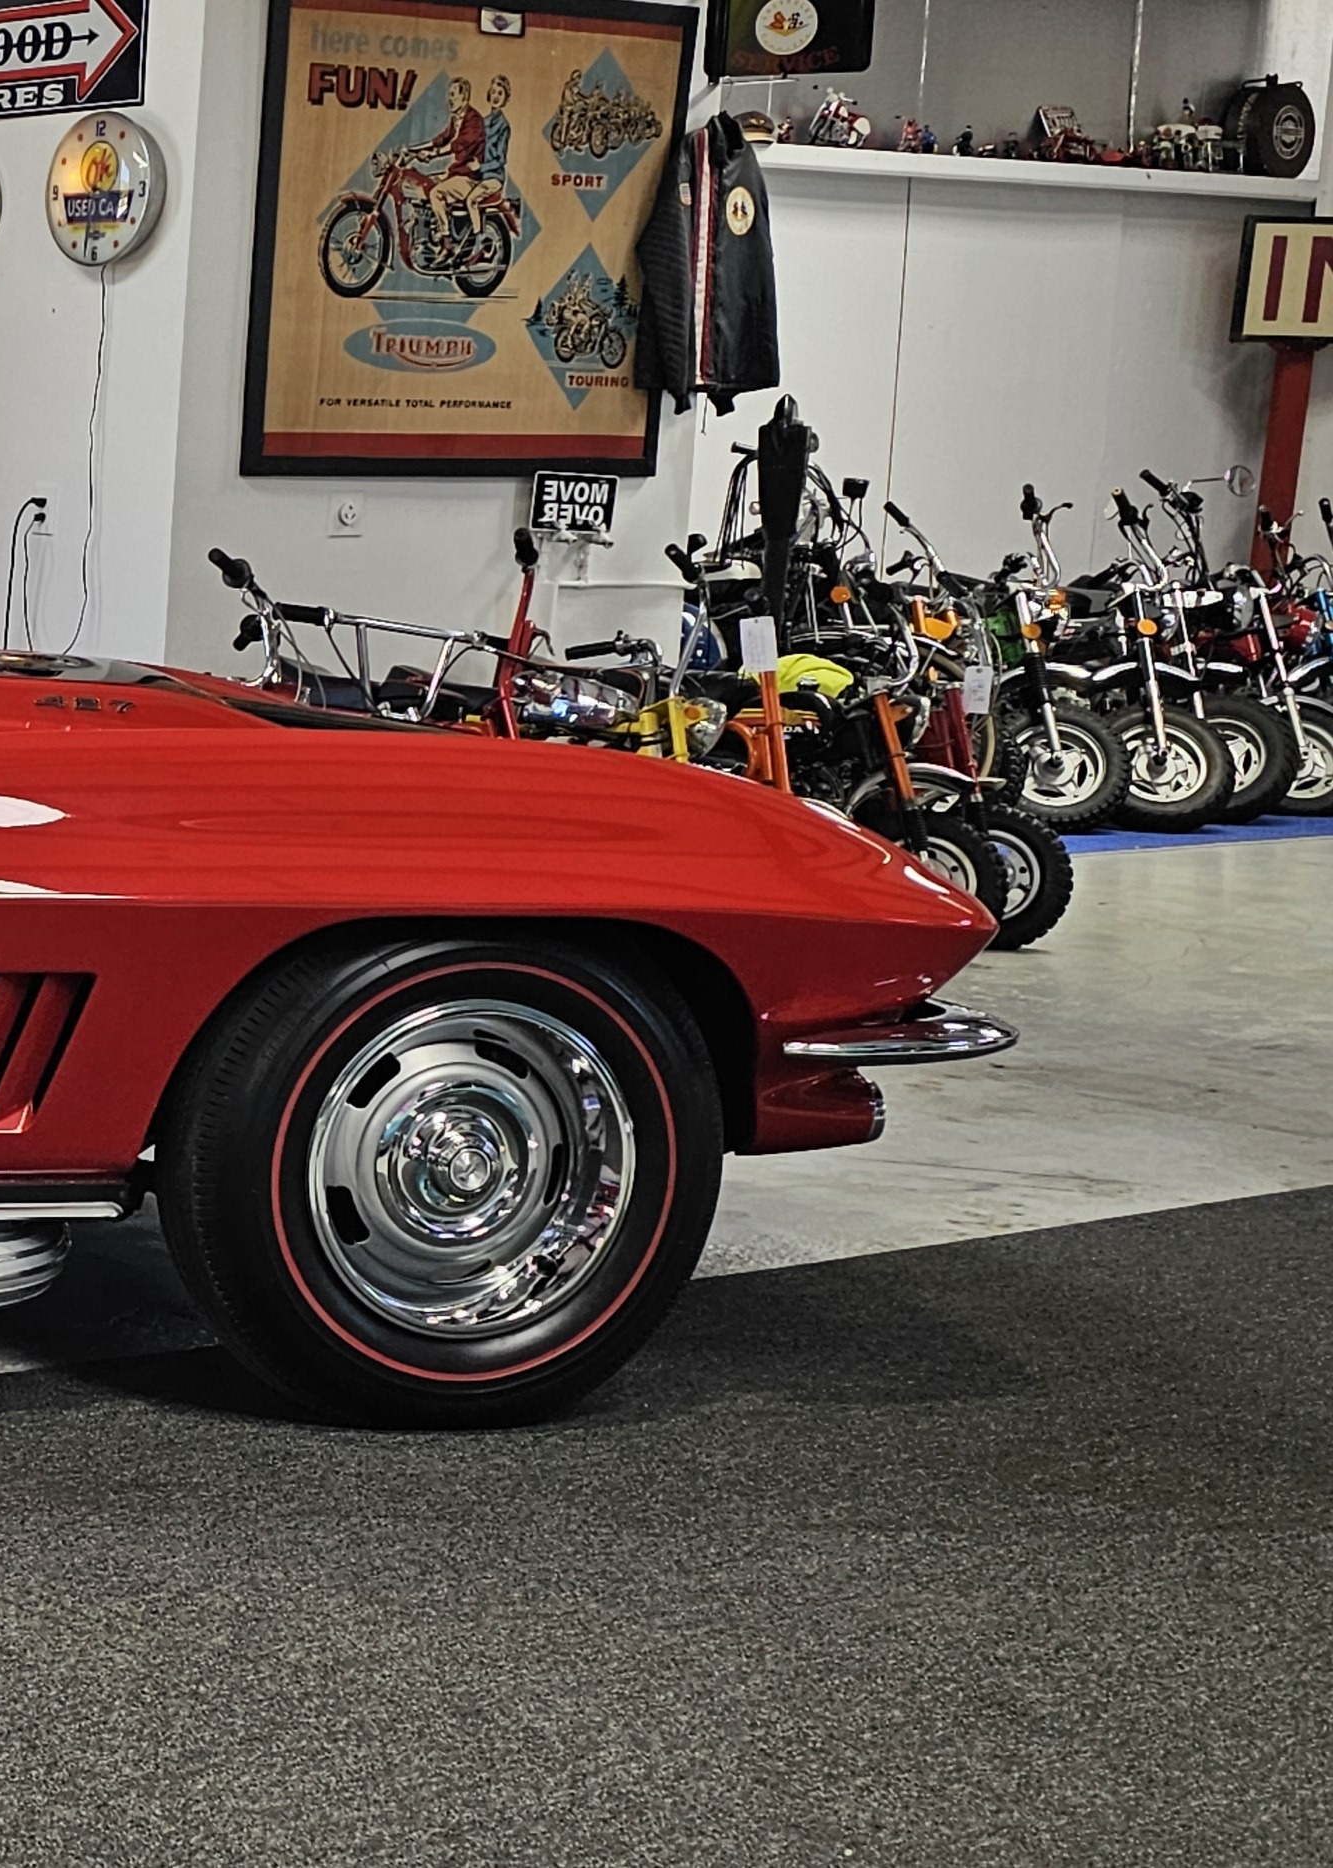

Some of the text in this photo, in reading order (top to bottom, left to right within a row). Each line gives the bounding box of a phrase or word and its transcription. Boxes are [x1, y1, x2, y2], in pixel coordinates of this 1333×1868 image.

[310, 20, 459, 62] here comes
[731, 46, 840, 73] SERVICE
[307, 62, 418, 111] FUN!
[95, 120, 107, 137] 12
[551, 173, 604, 188] SPORT
[52, 185, 59, 201] 9
[138, 181, 147, 198] 3
[67, 198, 96, 217] USED
[90, 247, 98, 262] 6
[372, 329, 474, 357] TRIUMPH
[567, 373, 630, 388] TOURING
[319, 398, 512, 410] FOR VERSATILE TOTAL PERFORMANCE
